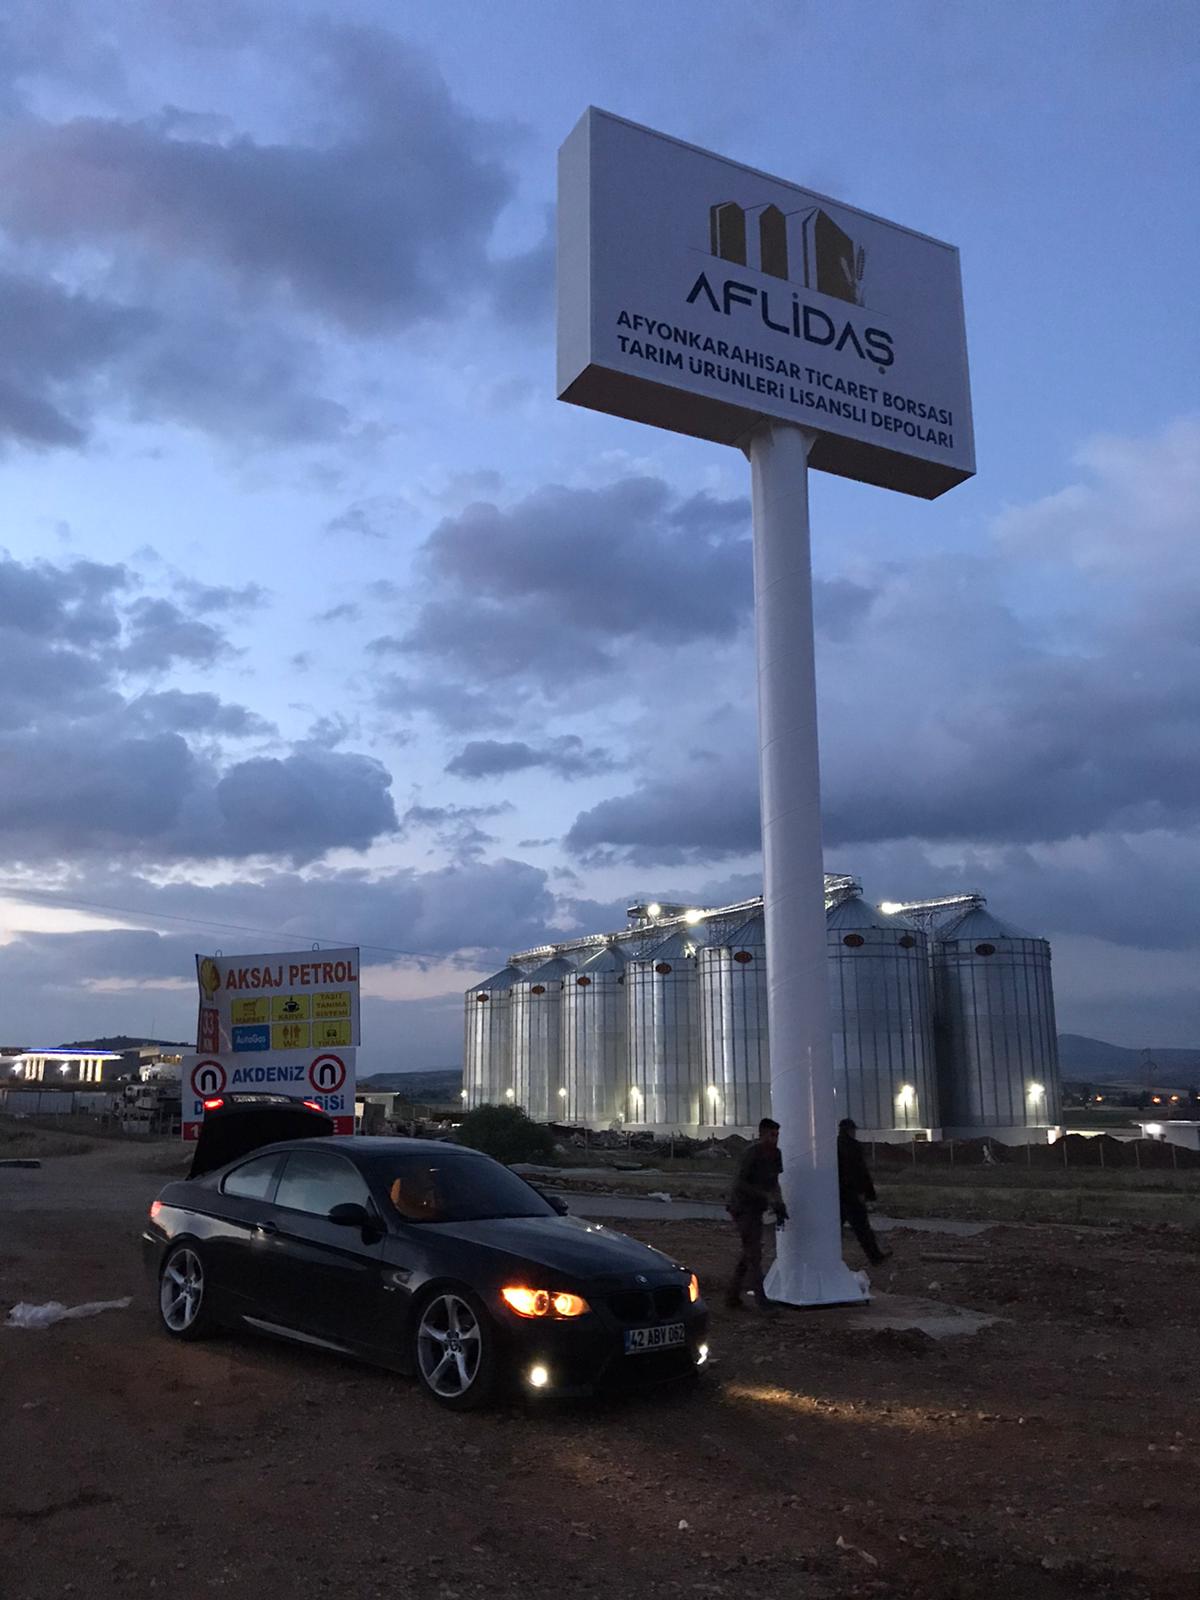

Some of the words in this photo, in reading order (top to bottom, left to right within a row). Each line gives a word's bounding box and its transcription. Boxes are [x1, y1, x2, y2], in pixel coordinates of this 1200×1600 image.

[686, 271, 894, 375] AFLİDAŞ
[616, 310, 801, 380] AFYONKARAHİSAR
[805, 367, 878, 403] TİCARET
[882, 391, 953, 426] BORSASI
[617, 335, 683, 370] TARIM
[689, 356, 785, 400] ÜRÜNLERİ
[790, 386, 866, 423] LİSANSLI
[871, 411, 954, 449] DEPOLARI
[226, 966, 283, 990] AKSAJ
[289, 961, 357, 986] PETROL
[283, 1040, 298, 1048] WC
[232, 1066, 305, 1084] AKDENİZ
[631, 1331, 644, 1347] 42
